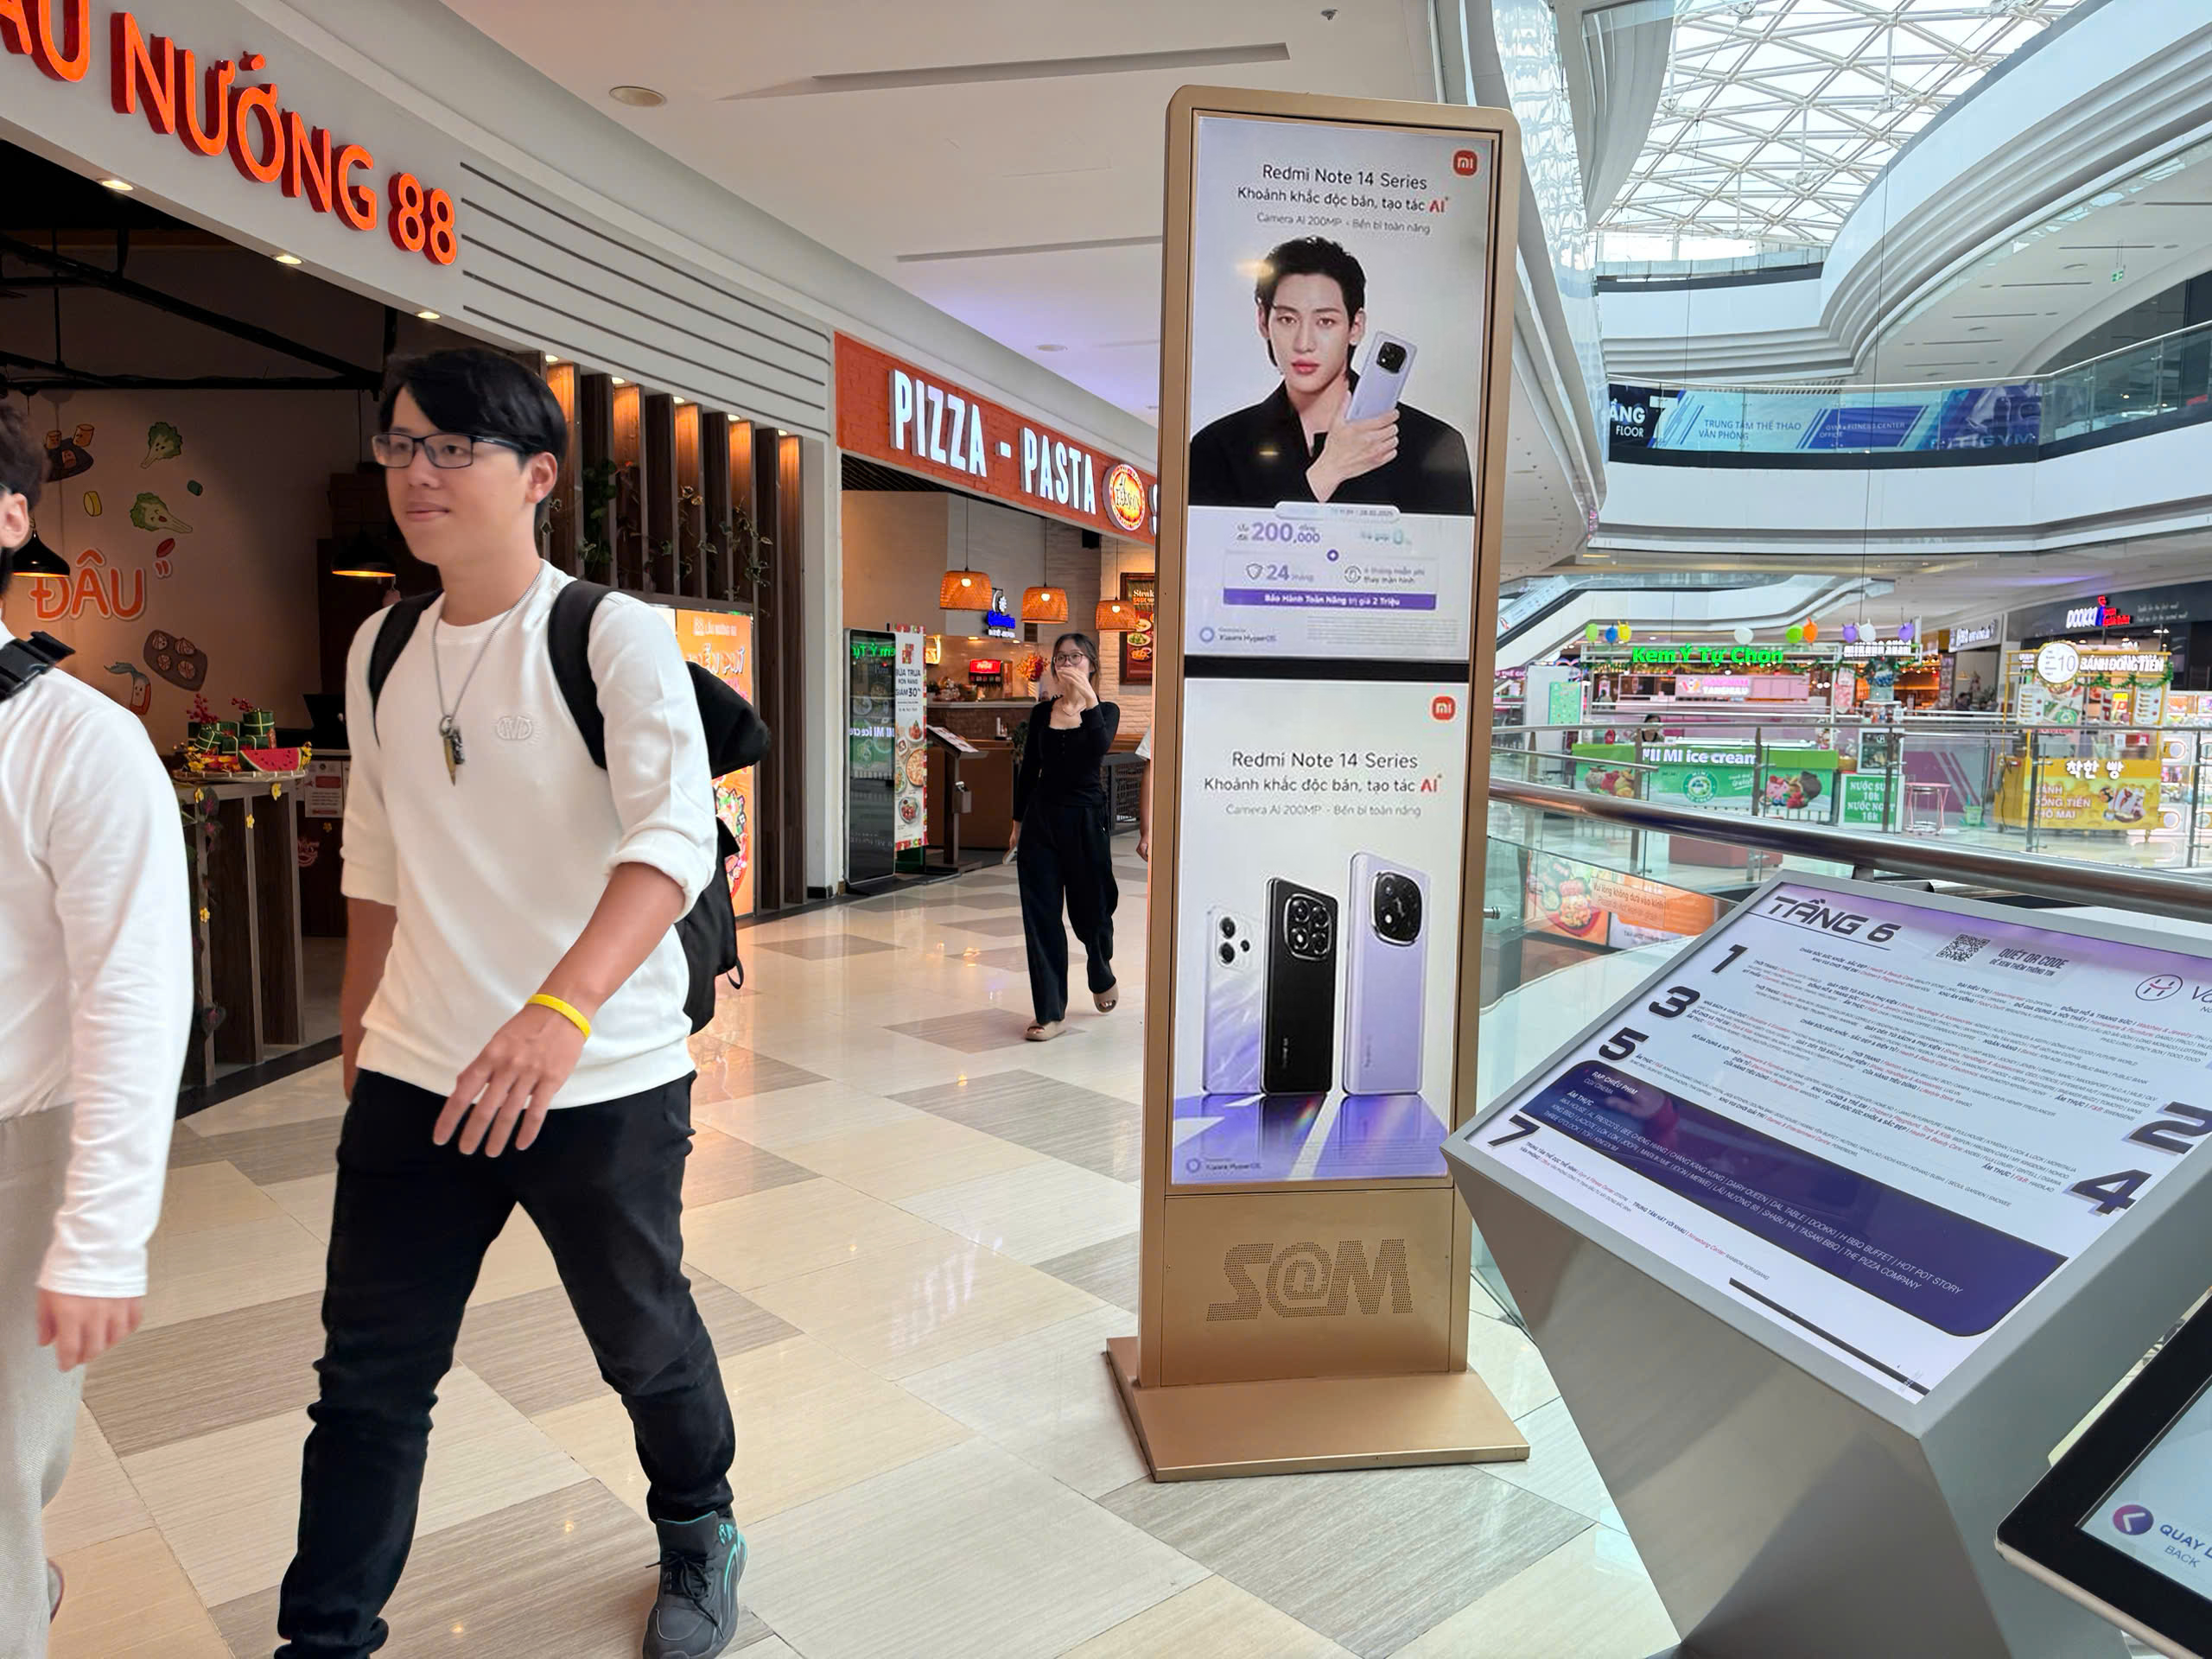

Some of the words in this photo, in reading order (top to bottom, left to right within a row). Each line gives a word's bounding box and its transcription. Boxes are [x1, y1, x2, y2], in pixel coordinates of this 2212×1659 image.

[110, 12, 378, 232] NƯỚNG
[388, 172, 458, 266] 88
[1262, 164, 1310, 181] Redmi
[1315, 168, 1352, 184] Note
[1357, 172, 1374, 186] 14
[1380, 173, 1427, 190] Series
[1237, 187, 1287, 201] Khoảnh
[1290, 188, 1320, 204] khắc
[1324, 193, 1348, 208] độc
[1382, 197, 1402, 213] tạo
[1406, 196, 1425, 211] tác
[1257, 212, 1294, 225] Camera
[1296, 215, 1306, 226] AI
[1307, 216, 1342, 226] 200MP
[1610, 397, 1645, 423] ẦNG
[1616, 425, 1643, 438] FLOOR
[1704, 419, 1733, 429] TRUNG
[1776, 422, 1802, 430] THAO
[889, 368, 987, 478] PIZZA
[1020, 427, 1096, 515] PASTA
[1266, 564, 1290, 581] 24
[1372, 597, 1378, 606] 2
[2066, 607, 2098, 628] DOOKKI
[1632, 647, 1675, 663] Kem
[1680, 643, 1693, 663] Ý
[1731, 646, 1784, 668] Chọn
[2057, 655, 2076, 672] 10
[1232, 751, 1285, 767] Redmi
[1291, 753, 1333, 768] Note
[1340, 753, 1357, 767] 14
[1365, 753, 1418, 769] Series
[1663, 748, 1682, 762] MI
[1686, 749, 1709, 764] ice
[1205, 776, 1259, 791] Khoảnh
[1263, 775, 1296, 791] khắc
[1301, 778, 1328, 794] độc
[1367, 779, 1389, 795] tạo
[1394, 778, 1415, 792] tác
[1875, 782, 1895, 792] SUI
[1225, 804, 1268, 815] Camera
[1268, 804, 1281, 815] AI
[1283, 804, 1322, 816] 200MP
[1874, 802, 1895, 811] NGT
[2056, 810, 2075, 819] MAI
[1767, 895, 1870, 935] TẦNG
[1866, 923, 1903, 943] 6
[1712, 944, 1748, 974] 1
[1998, 948, 2027, 962] QUÉT
[2024, 953, 2043, 965] QR
[2038, 956, 2069, 969] CODE
[1998, 959, 2012, 969] XEM
[1649, 985, 1700, 1019] 3
[1598, 1027, 1649, 1061] 5
[1622, 1084, 1637, 1094] PHIM
[1488, 1114, 1541, 1147] 7
[2126, 1101, 2212, 1155] 2
[2067, 1169, 2152, 1215] 4
[1727, 1179, 1745, 1191] DAIRY
[1745, 1188, 1769, 1202] QUEEN
[1770, 1200, 1785, 1210] DAL
[1785, 1207, 1806, 1220] TABLE
[1809, 1219, 1838, 1235] DOOKKI
[1847, 1236, 1865, 1249] BBQ
[1865, 1245, 1894, 1262] BUFFET
[1897, 1261, 1915, 1272] HOT
[1916, 1269, 1933, 1281] POT
[1933, 1277, 1962, 1294] STORY
[1763, 1209, 1786, 1224] SHABU
[1800, 1227, 1824, 1242] TASAKI
[1823, 1239, 1840, 1250] BBQ
[1844, 1249, 1859, 1259] THE
[1859, 1256, 1882, 1270] PIZZA
[1881, 1267, 1922, 1289] COMPANY
[2160, 1524, 2205, 1550] QUAY
[2164, 1545, 2201, 1567] BACK
